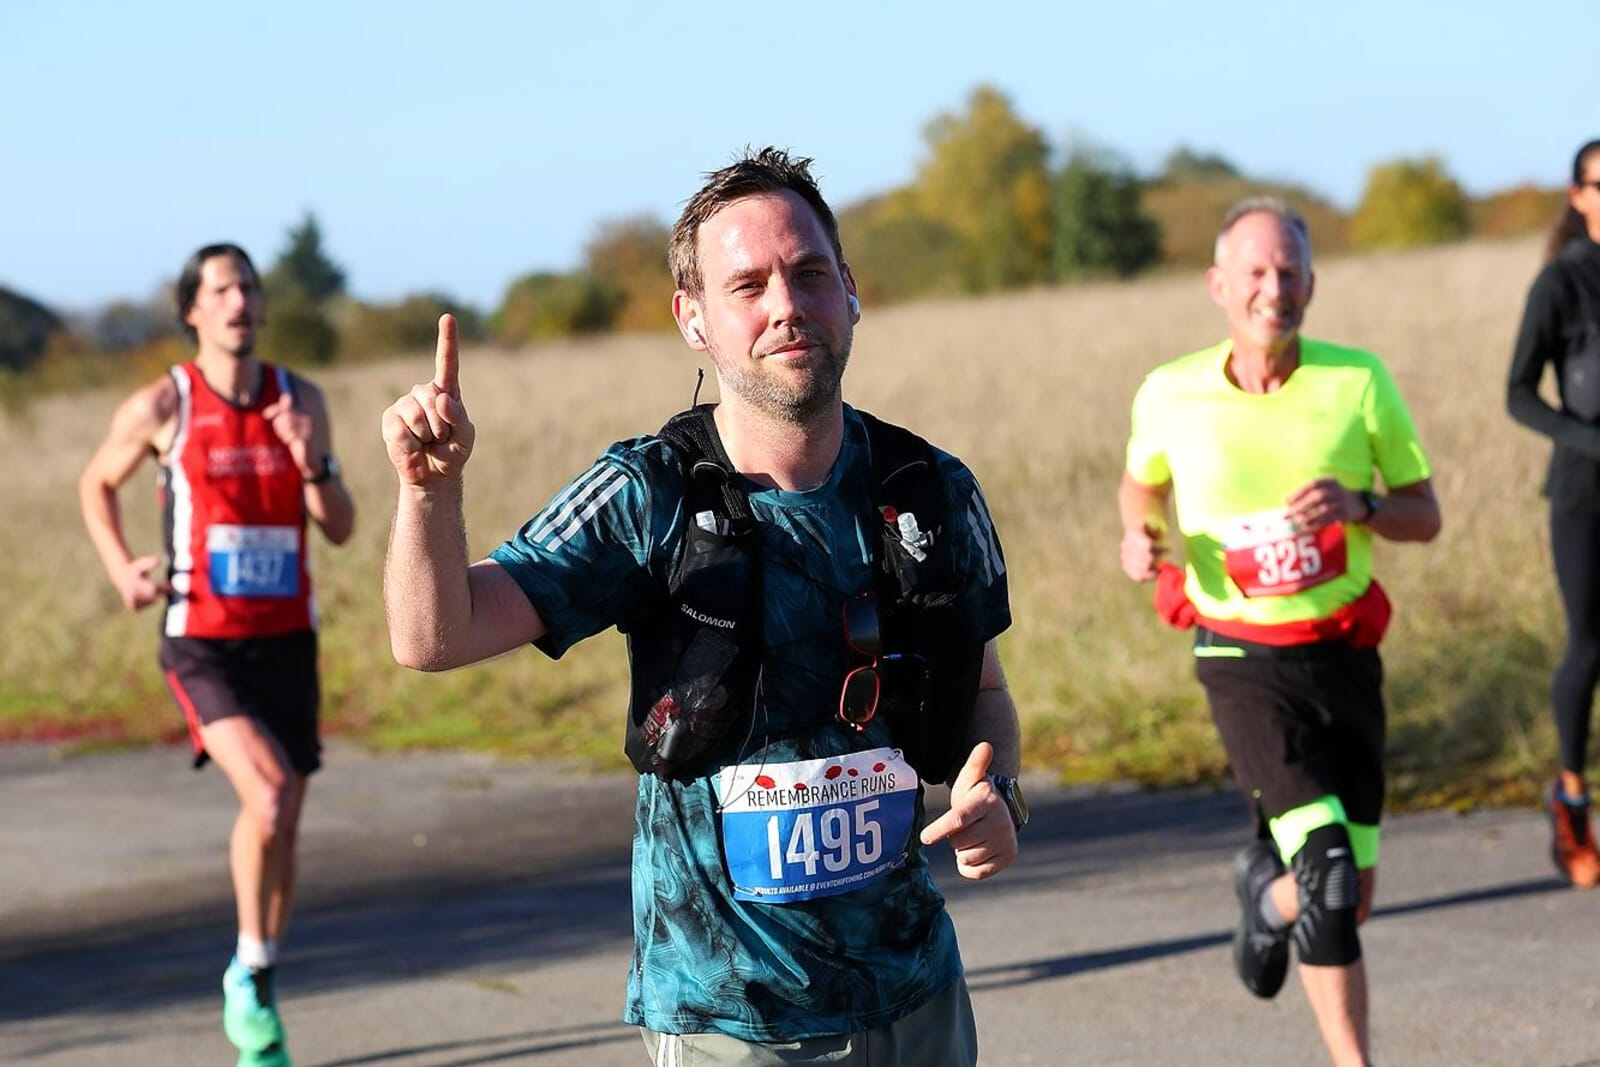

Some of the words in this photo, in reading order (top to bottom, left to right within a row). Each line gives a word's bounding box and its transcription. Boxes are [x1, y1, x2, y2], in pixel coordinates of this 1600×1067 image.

[227, 551, 285, 587] 1437
[1254, 535, 1322, 586] 325
[681, 603, 735, 629] SALOMON
[747, 778, 859, 807] REMEMBRANCE
[861, 773, 896, 794] RUNS
[766, 799, 883, 880] 1495
[779, 883, 809, 894] AVAILABLE
